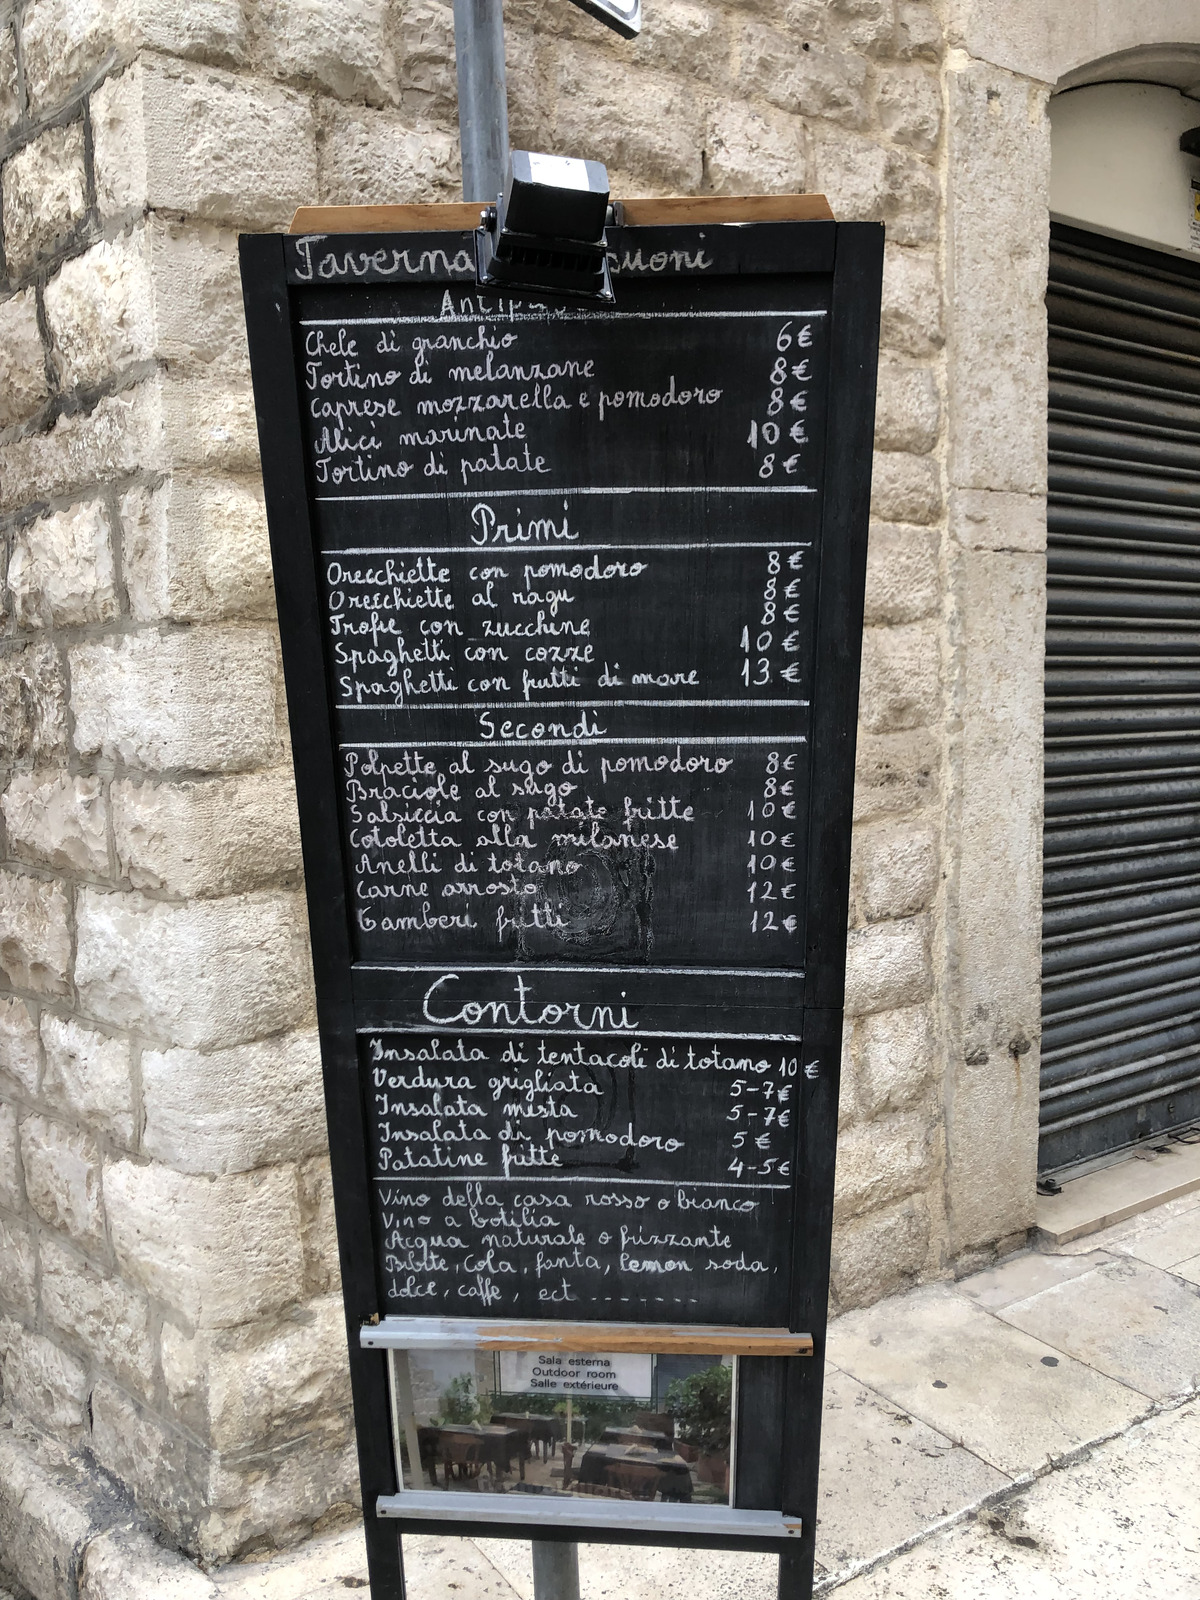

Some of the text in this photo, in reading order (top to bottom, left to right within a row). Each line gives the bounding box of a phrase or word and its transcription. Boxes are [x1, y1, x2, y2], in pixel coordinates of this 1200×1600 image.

[295, 236, 475, 280] Taverna
[305, 328, 358, 357] Chele
[377, 329, 400, 353] di
[412, 326, 518, 362] granchio
[305, 361, 402, 390] Tortino
[409, 369, 432, 385] di
[448, 352, 595, 383] melanzane
[417, 384, 572, 421] mozzarella
[579, 392, 591, 409] e
[599, 375, 723, 421] pomodoro
[314, 421, 382, 454] Alici
[400, 412, 526, 447] marinate
[316, 455, 414, 484] Tortino
[423, 453, 448, 476] di
[460, 443, 552, 485] patate
[470, 500, 579, 545] Primi
[327, 556, 450, 585] Orecchiette
[469, 564, 509, 580] con
[524, 554, 648, 591] pomodoro
[328, 585, 454, 611] Orecchiette
[471, 581, 499, 608] al
[419, 618, 464, 636] con
[482, 610, 591, 637] zucchine
[334, 637, 450, 677] Spaghetti
[464, 645, 509, 662] con
[525, 644, 595, 663] cozze
[339, 667, 459, 706] Spaghetti
[467, 676, 512, 692] con
[522, 666, 581, 701] frutti
[597, 661, 624, 687] di
[479, 709, 607, 739] Secondi
[343, 750, 436, 787] Polpette
[449, 750, 475, 774] al
[484, 757, 552, 788] sugo
[562, 750, 589, 774] di
[600, 745, 733, 784] pomodoro
[346, 774, 461, 803] Braciole
[475, 775, 501, 798] al
[512, 781, 578, 807] sugo
[351, 800, 462, 824] Salsiccia
[477, 807, 514, 823] con
[623, 796, 695, 832] fritte
[350, 823, 462, 848] Cotoletta
[476, 823, 537, 848] alla
[551, 821, 679, 849] milanese
[355, 851, 442, 875] Anelli
[454, 852, 478, 873] di
[488, 852, 582, 875] totano
[356, 880, 429, 899] Carne
[441, 874, 537, 898] arrosto
[358, 901, 477, 932] Gamberi
[423, 973, 639, 1029] Contorni
[369, 1038, 489, 1062] Insalata
[500, 1040, 529, 1063] di
[537, 1040, 648, 1068] tentacoli
[656, 1046, 679, 1069] di
[683, 1044, 771, 1072] totano
[372, 1066, 476, 1089] Verdura
[488, 1068, 604, 1101] grigliata
[375, 1093, 488, 1117] Insalata
[503, 1097, 578, 1118] mista
[378, 1120, 491, 1143] Insalata
[498, 1120, 531, 1142] di
[546, 1123, 685, 1152] pomodoro
[378, 1143, 488, 1171] Patatine
[502, 1143, 563, 1179] fritte
[379, 1182, 759, 1212] Vino della casa rosso o bianco
[382, 1212, 432, 1229] Vino
[445, 1215, 462, 1228] a
[385, 1225, 732, 1260] Acqua naturale o frizzante
[620, 1252, 693, 1273] lemon
[532, 1367, 617, 1379] Outdoor room
[538, 1355, 611, 1367] Sala esterna
[530, 1378, 619, 1391] Salle extérieure
